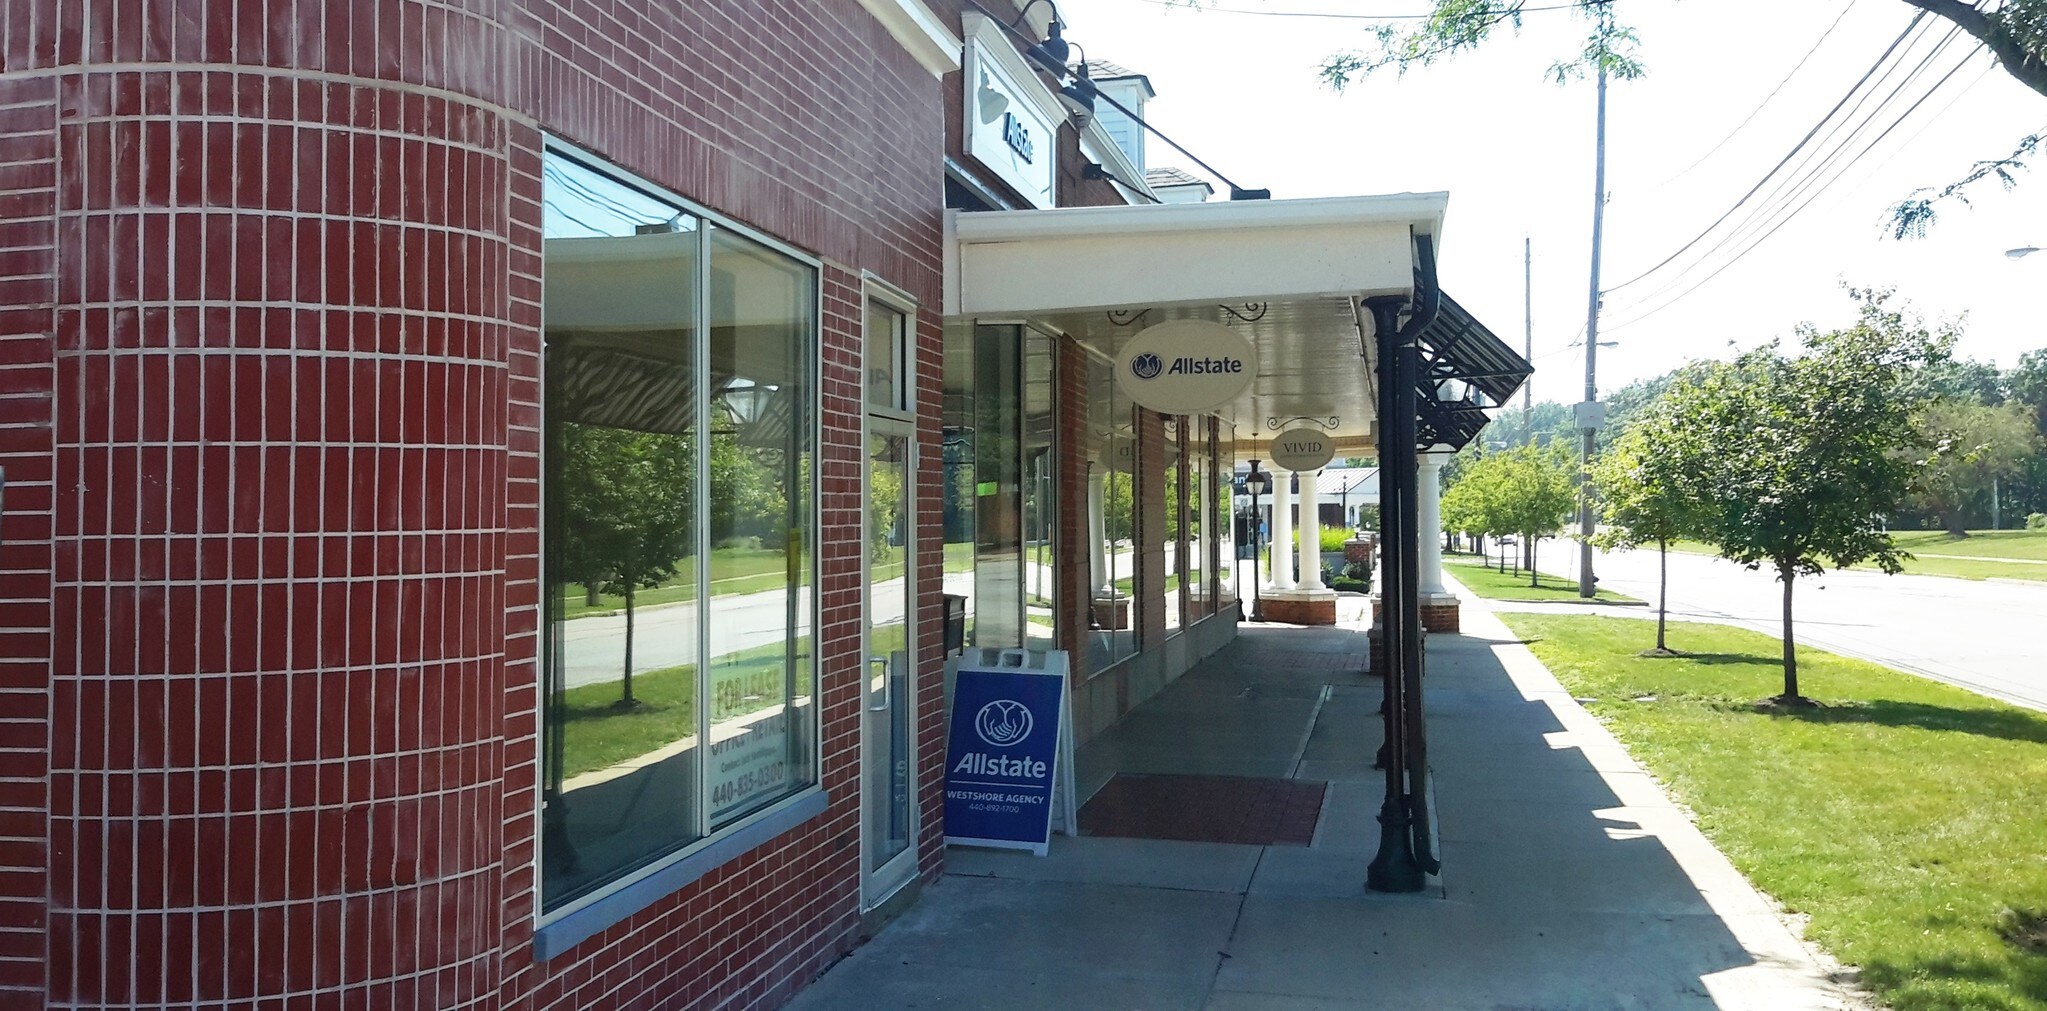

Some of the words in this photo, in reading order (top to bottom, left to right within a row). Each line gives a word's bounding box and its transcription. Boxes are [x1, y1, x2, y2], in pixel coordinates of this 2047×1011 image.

[1168, 356, 1242, 375] Allstate
[1283, 441, 1322, 453] VIVID
[716, 676, 742, 716] FOR
[953, 752, 1047, 779] Allstate
[712, 760, 784, 807] 440-835-0300
[947, 790, 1004, 803] WESTSHORE
[1006, 794, 1045, 805] AGENCY
[968, 803, 1020, 813] 440-892-1700
